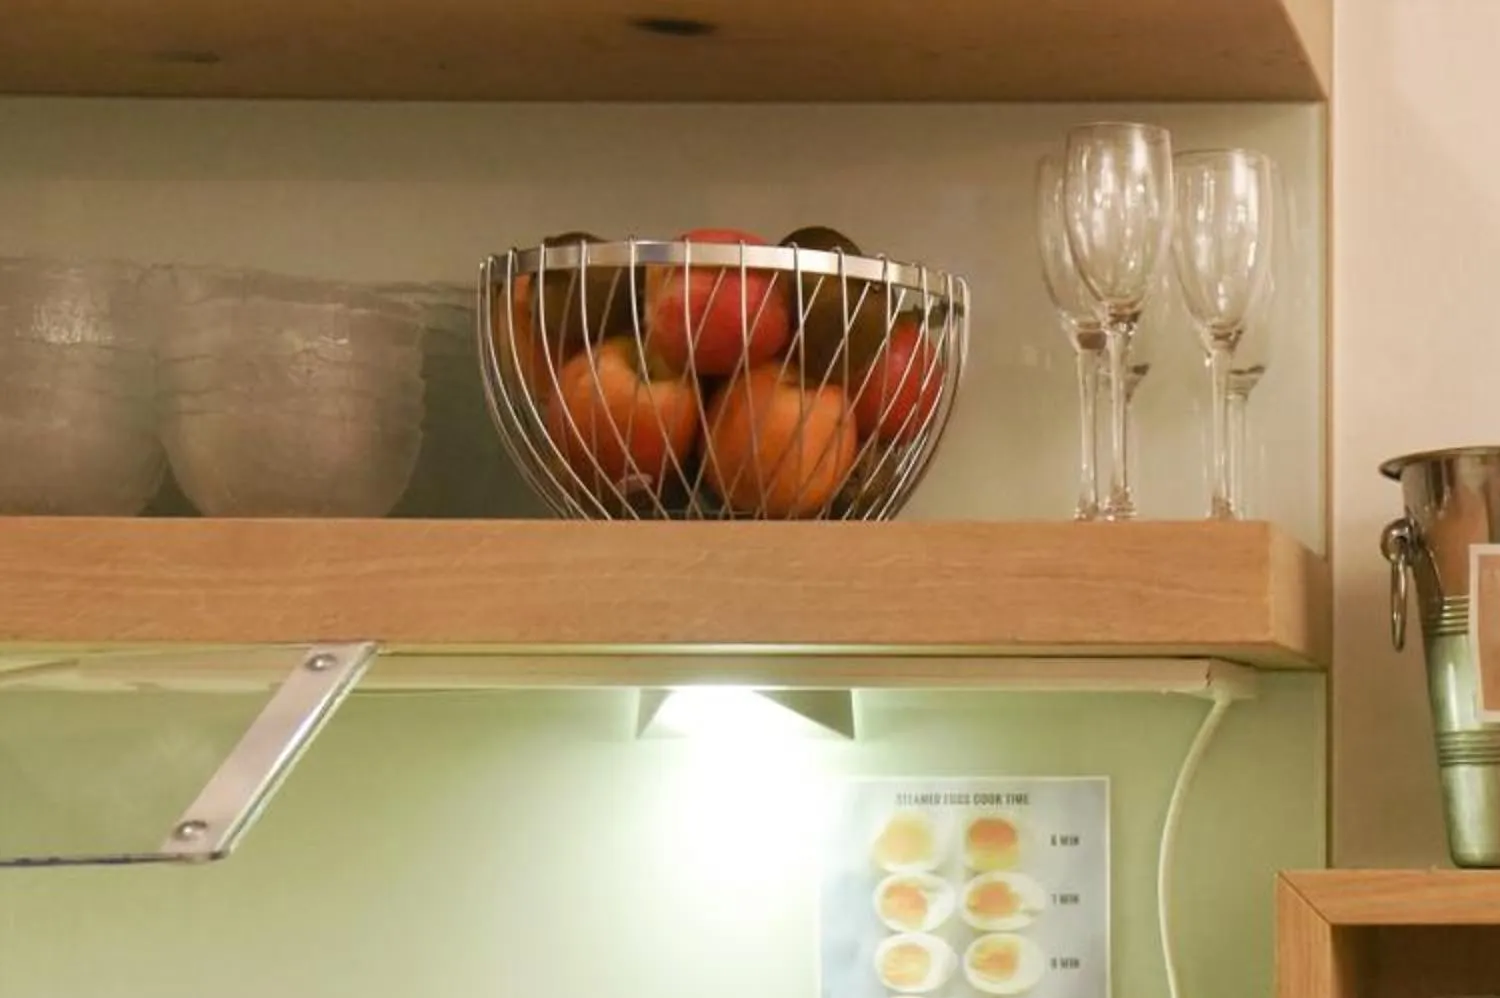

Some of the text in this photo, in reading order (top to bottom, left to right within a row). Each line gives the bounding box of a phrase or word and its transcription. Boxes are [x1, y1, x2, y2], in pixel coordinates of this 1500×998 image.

[1005, 792, 1030, 806] TIME
[1060, 834, 1080, 846] MIN
[1060, 893, 1080, 905] MIN
[1060, 957, 1080, 969] MIN
